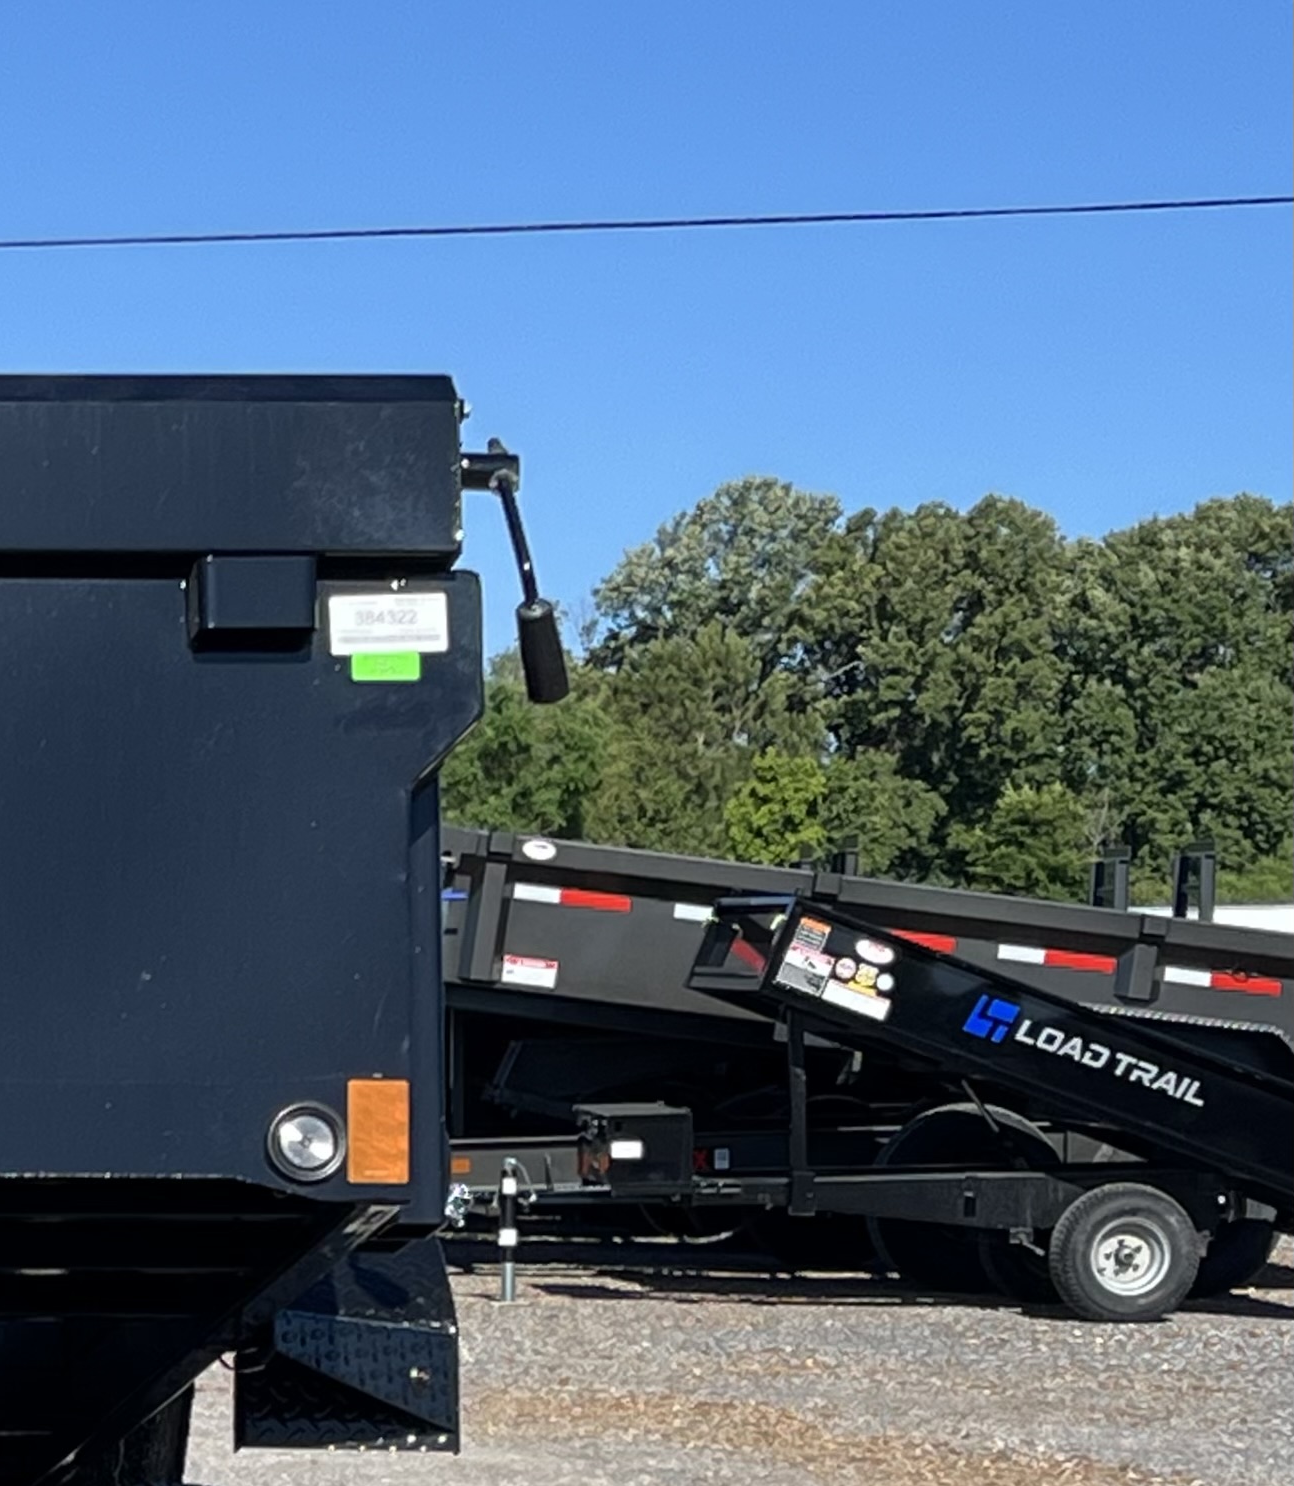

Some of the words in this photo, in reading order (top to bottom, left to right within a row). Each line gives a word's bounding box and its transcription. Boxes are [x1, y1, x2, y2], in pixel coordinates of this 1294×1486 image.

[354, 609, 418, 627] 384322
[1014, 1018, 1111, 1069] LOAD
[1113, 1052, 1205, 1108] TRAIL
